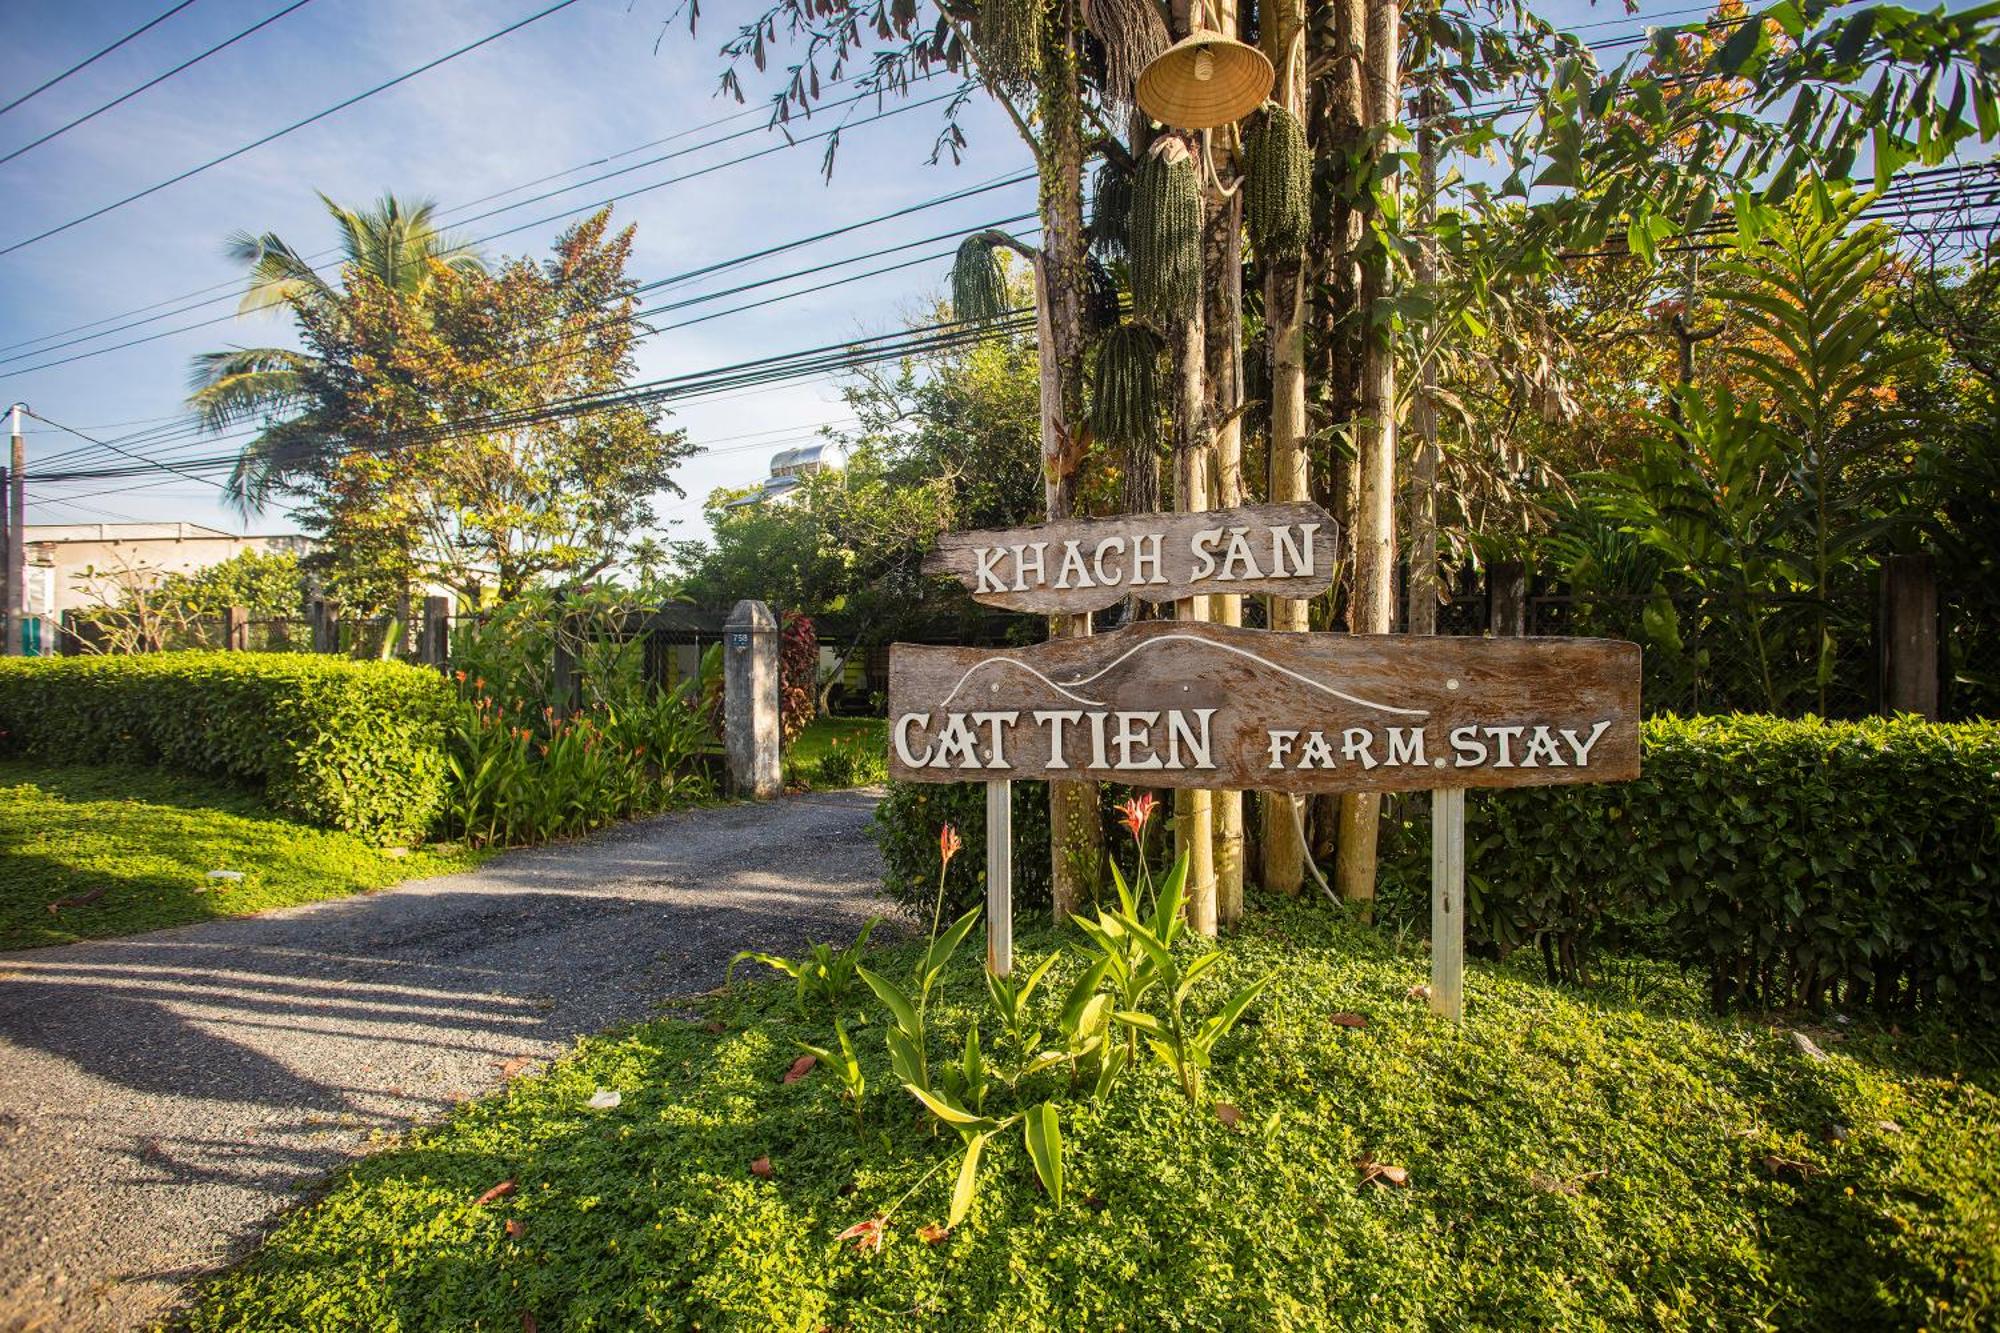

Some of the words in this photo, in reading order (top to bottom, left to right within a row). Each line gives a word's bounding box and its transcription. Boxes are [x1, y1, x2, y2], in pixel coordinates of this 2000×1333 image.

[972, 533, 1169, 594] KHACH
[1190, 523, 1321, 584] SAN
[894, 710, 1019, 769] CAT
[1032, 708, 1219, 770] TIEN
